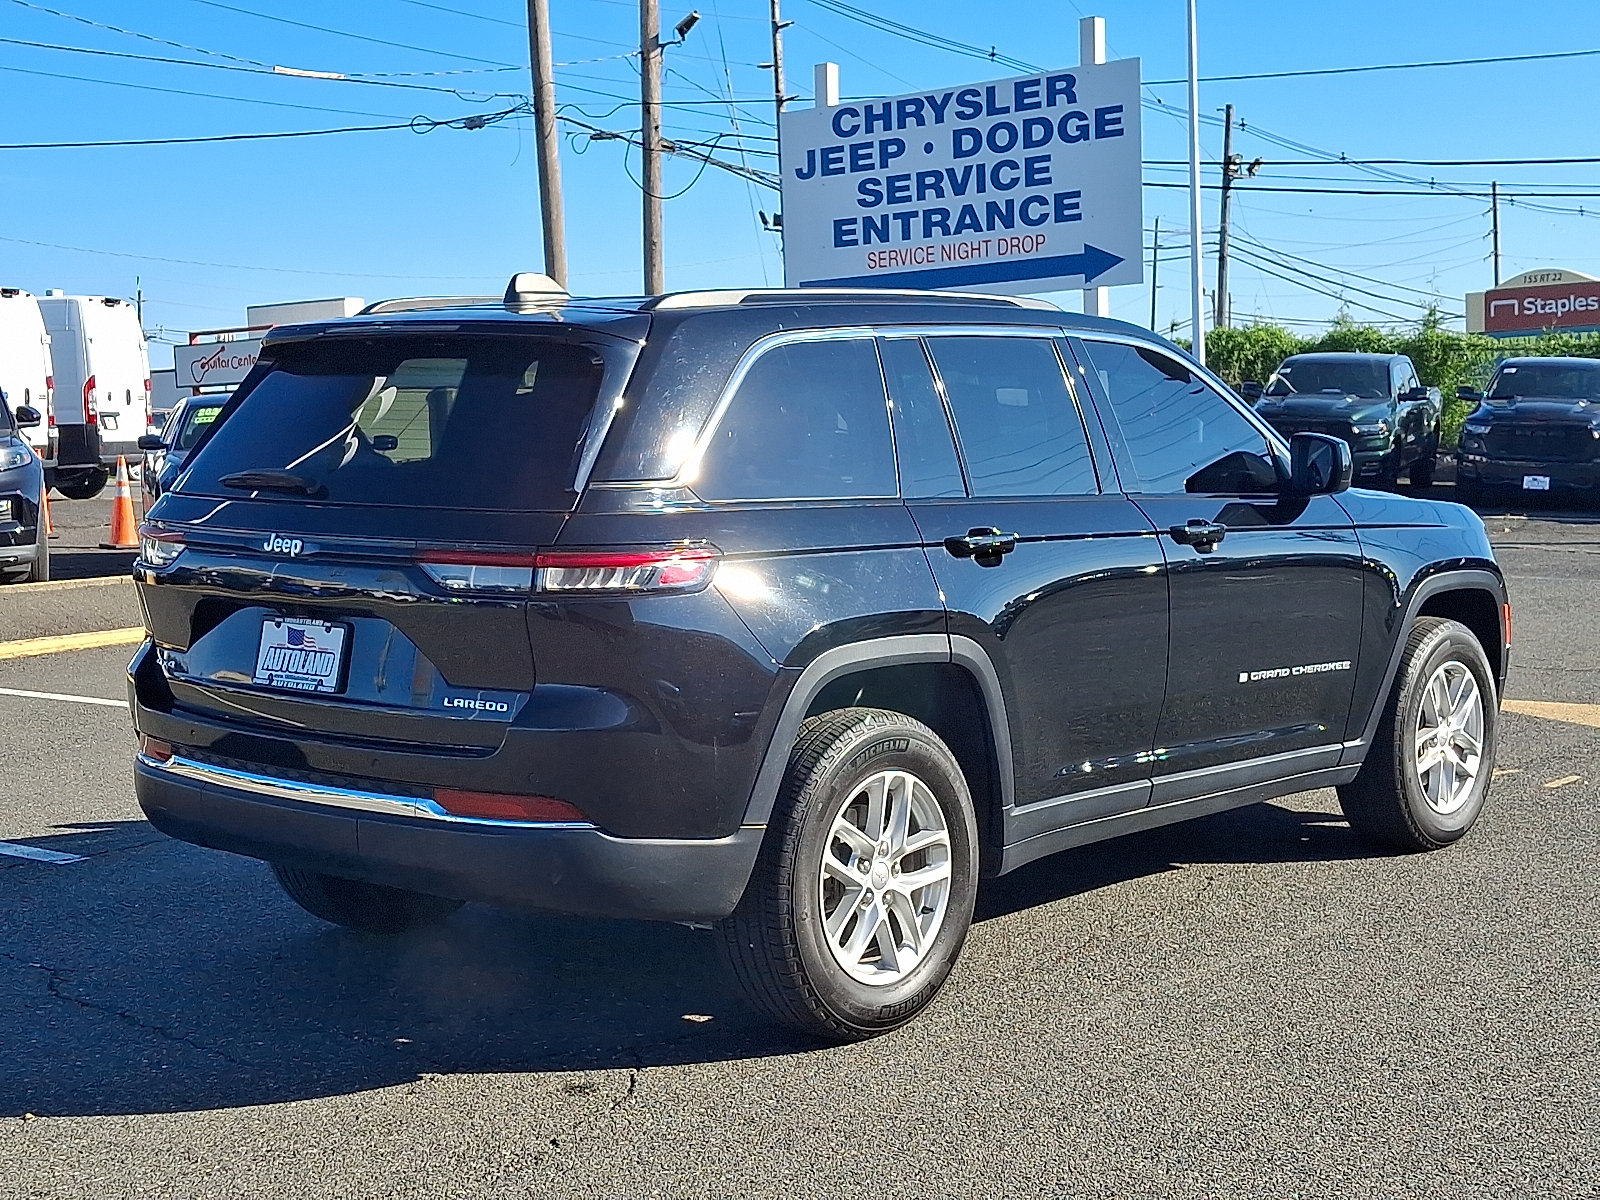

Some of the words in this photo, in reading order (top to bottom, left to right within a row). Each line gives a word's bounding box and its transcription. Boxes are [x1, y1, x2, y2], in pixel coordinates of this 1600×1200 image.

[832, 73, 1077, 138] CHRYSLER
[795, 138, 906, 180] JEEP
[952, 104, 1125, 160] DODGE
[857, 154, 1052, 208] SERVICE
[833, 190, 1083, 248] ENTRANCE
[867, 246, 935, 270] SERVICE
[940, 240, 992, 262] NIGHT
[997, 234, 1047, 256] DROP
[1523, 275, 1538, 284] 155
[1540, 274, 1551, 283] RT
[1523, 295, 1599, 317] Staples
[231, 354, 257, 369] Cente
[264, 533, 303, 557] Jeep
[262, 647, 335, 677] AUTOLAND
[1250, 668, 1290, 680] GRAND
[1292, 661, 1351, 675] CHEROKEE
[271, 680, 315, 691] AUTOLAND
[444, 697, 508, 712] LAREDO
[857, 740, 908, 768] MICHELIN
